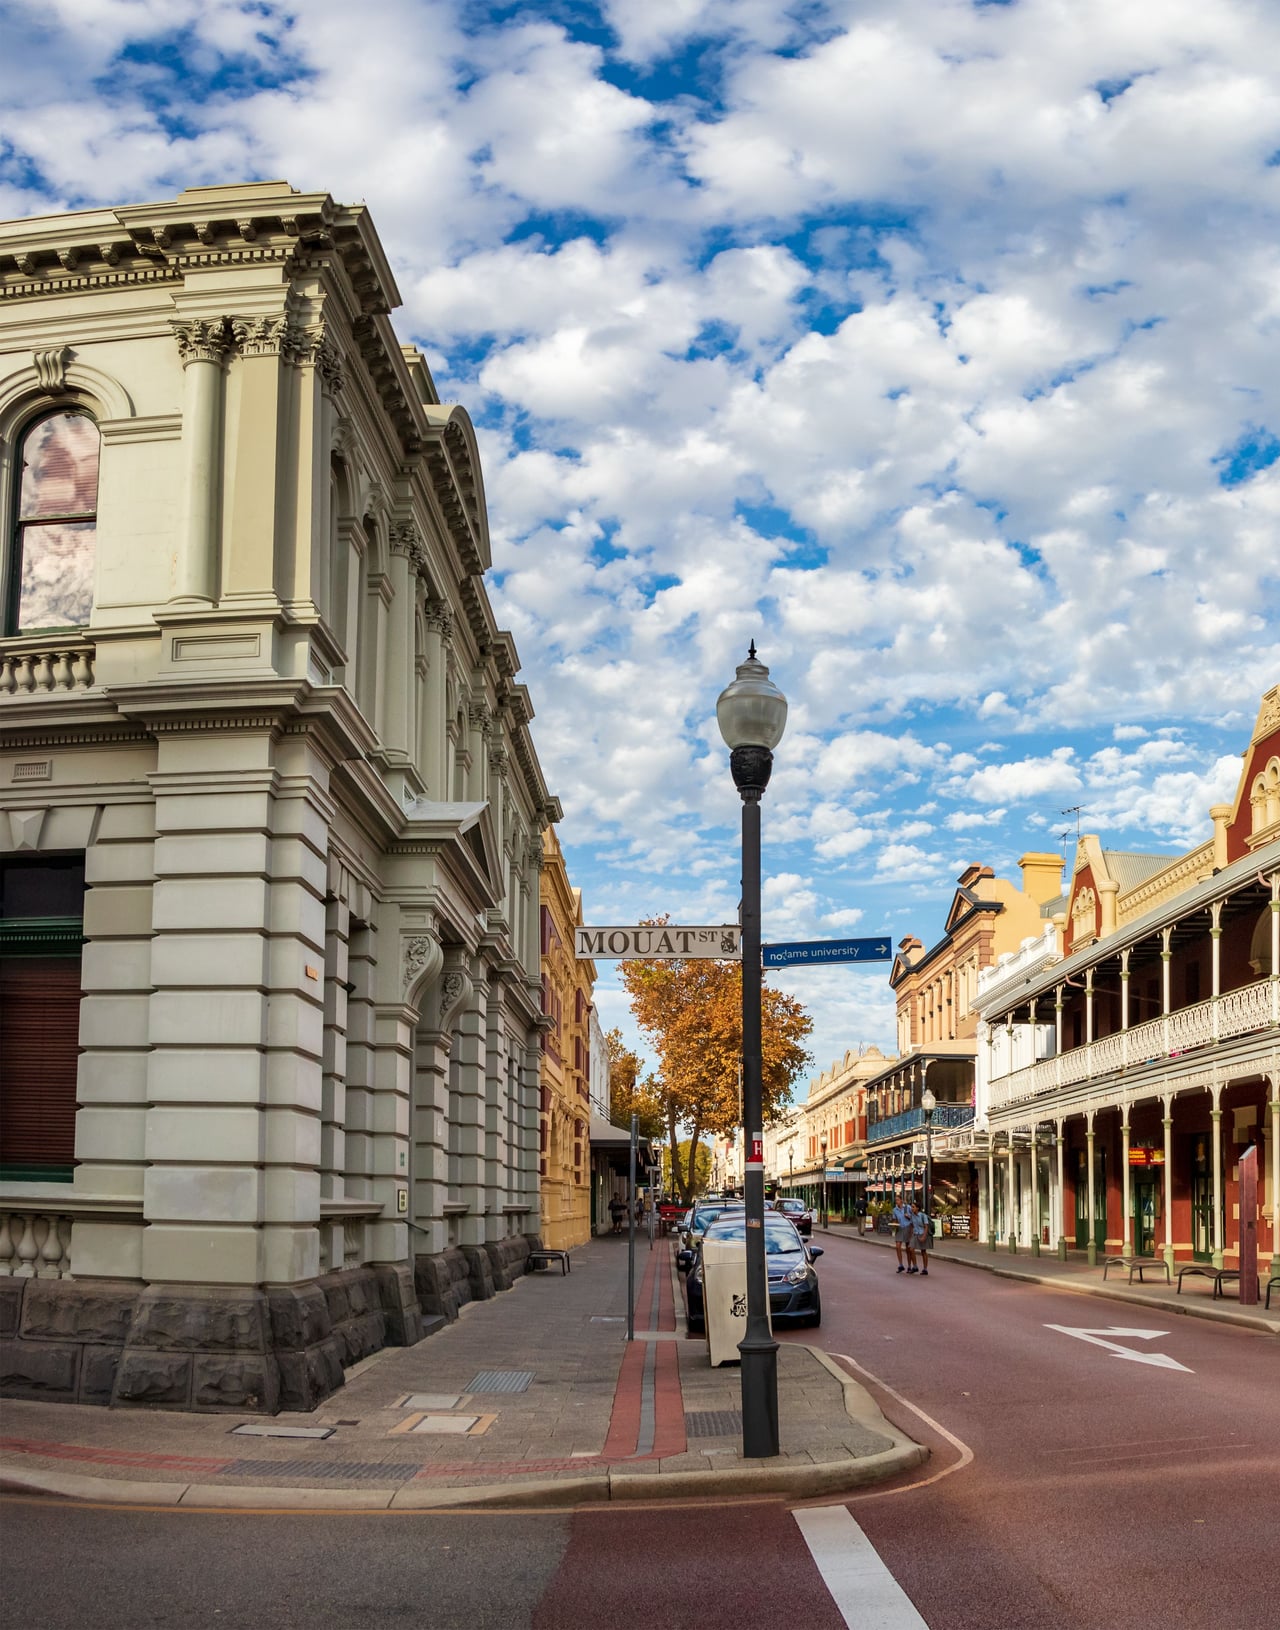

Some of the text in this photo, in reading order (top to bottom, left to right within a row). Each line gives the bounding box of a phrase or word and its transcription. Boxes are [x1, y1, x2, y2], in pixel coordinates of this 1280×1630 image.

[578, 931, 717, 954] MOUAT ST
[811, 946, 860, 957] university
